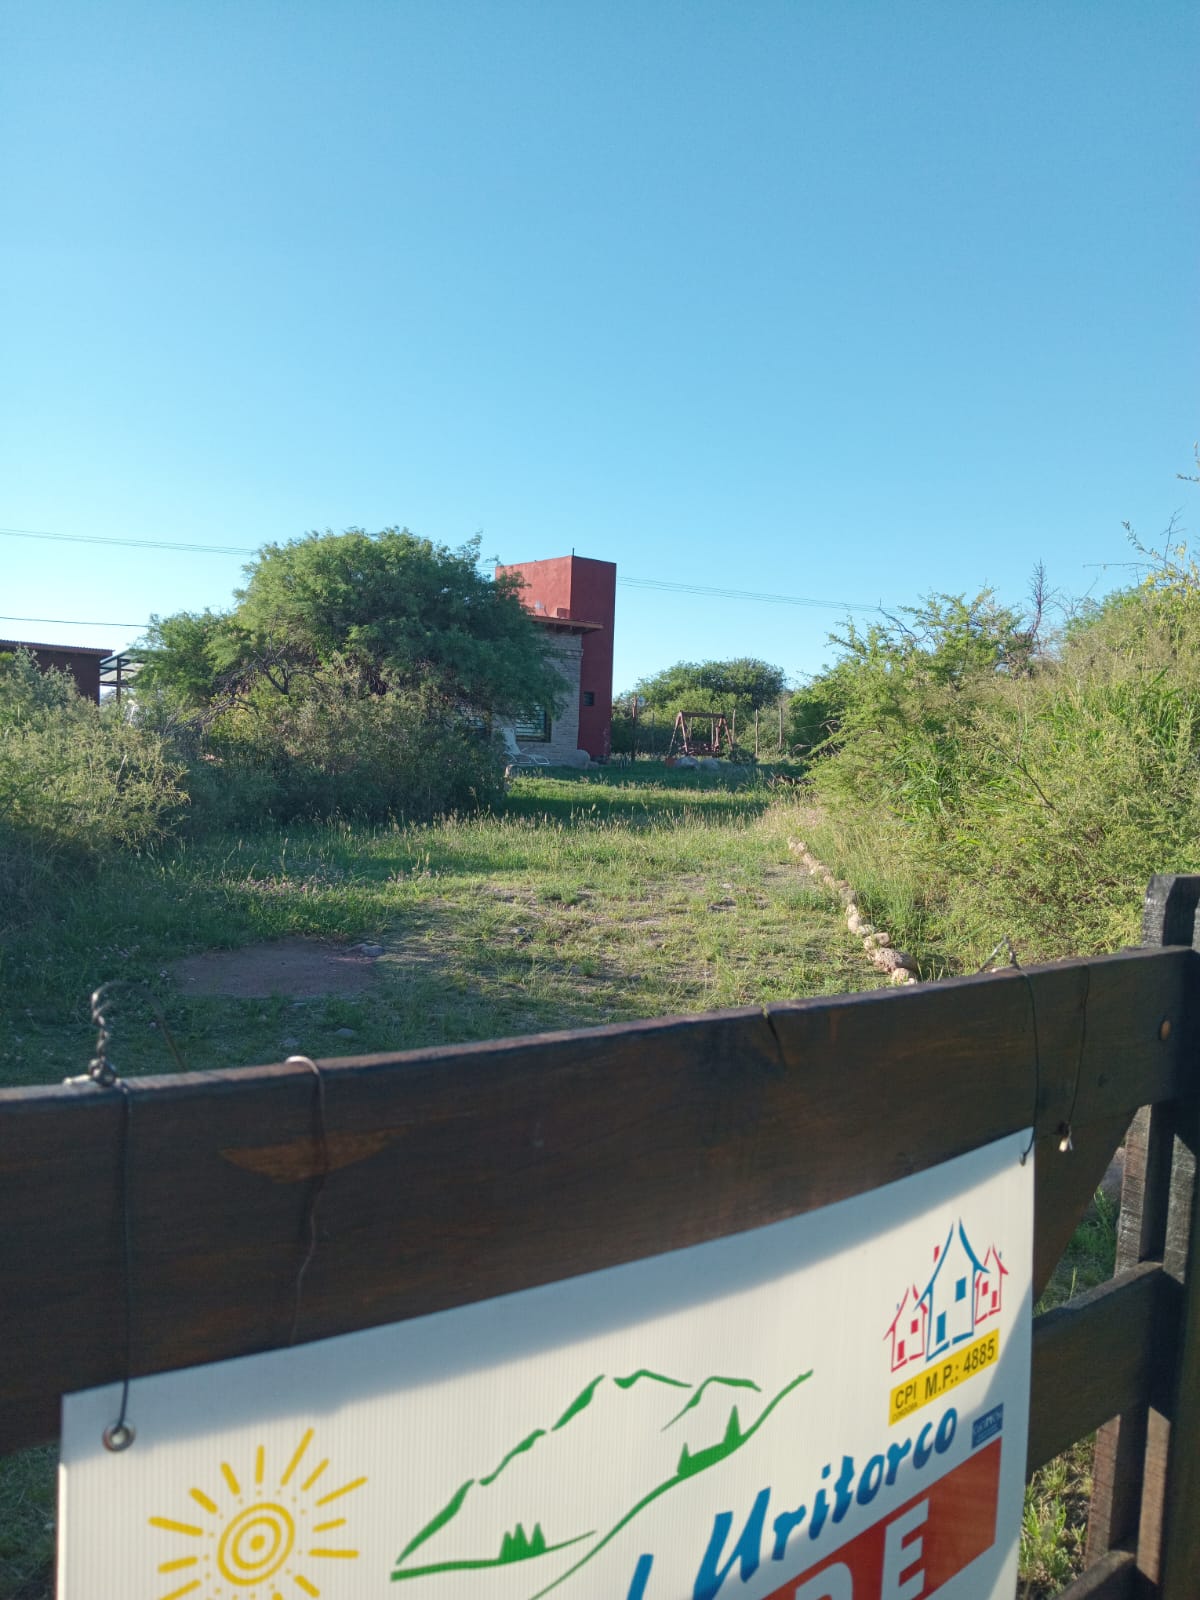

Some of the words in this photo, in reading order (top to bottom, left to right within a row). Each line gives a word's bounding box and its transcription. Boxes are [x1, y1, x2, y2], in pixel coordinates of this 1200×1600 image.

[896, 1381, 917, 1409] CPI
[963, 1337, 995, 1374] 4885
[692, 1407, 957, 1600] Uritorco
